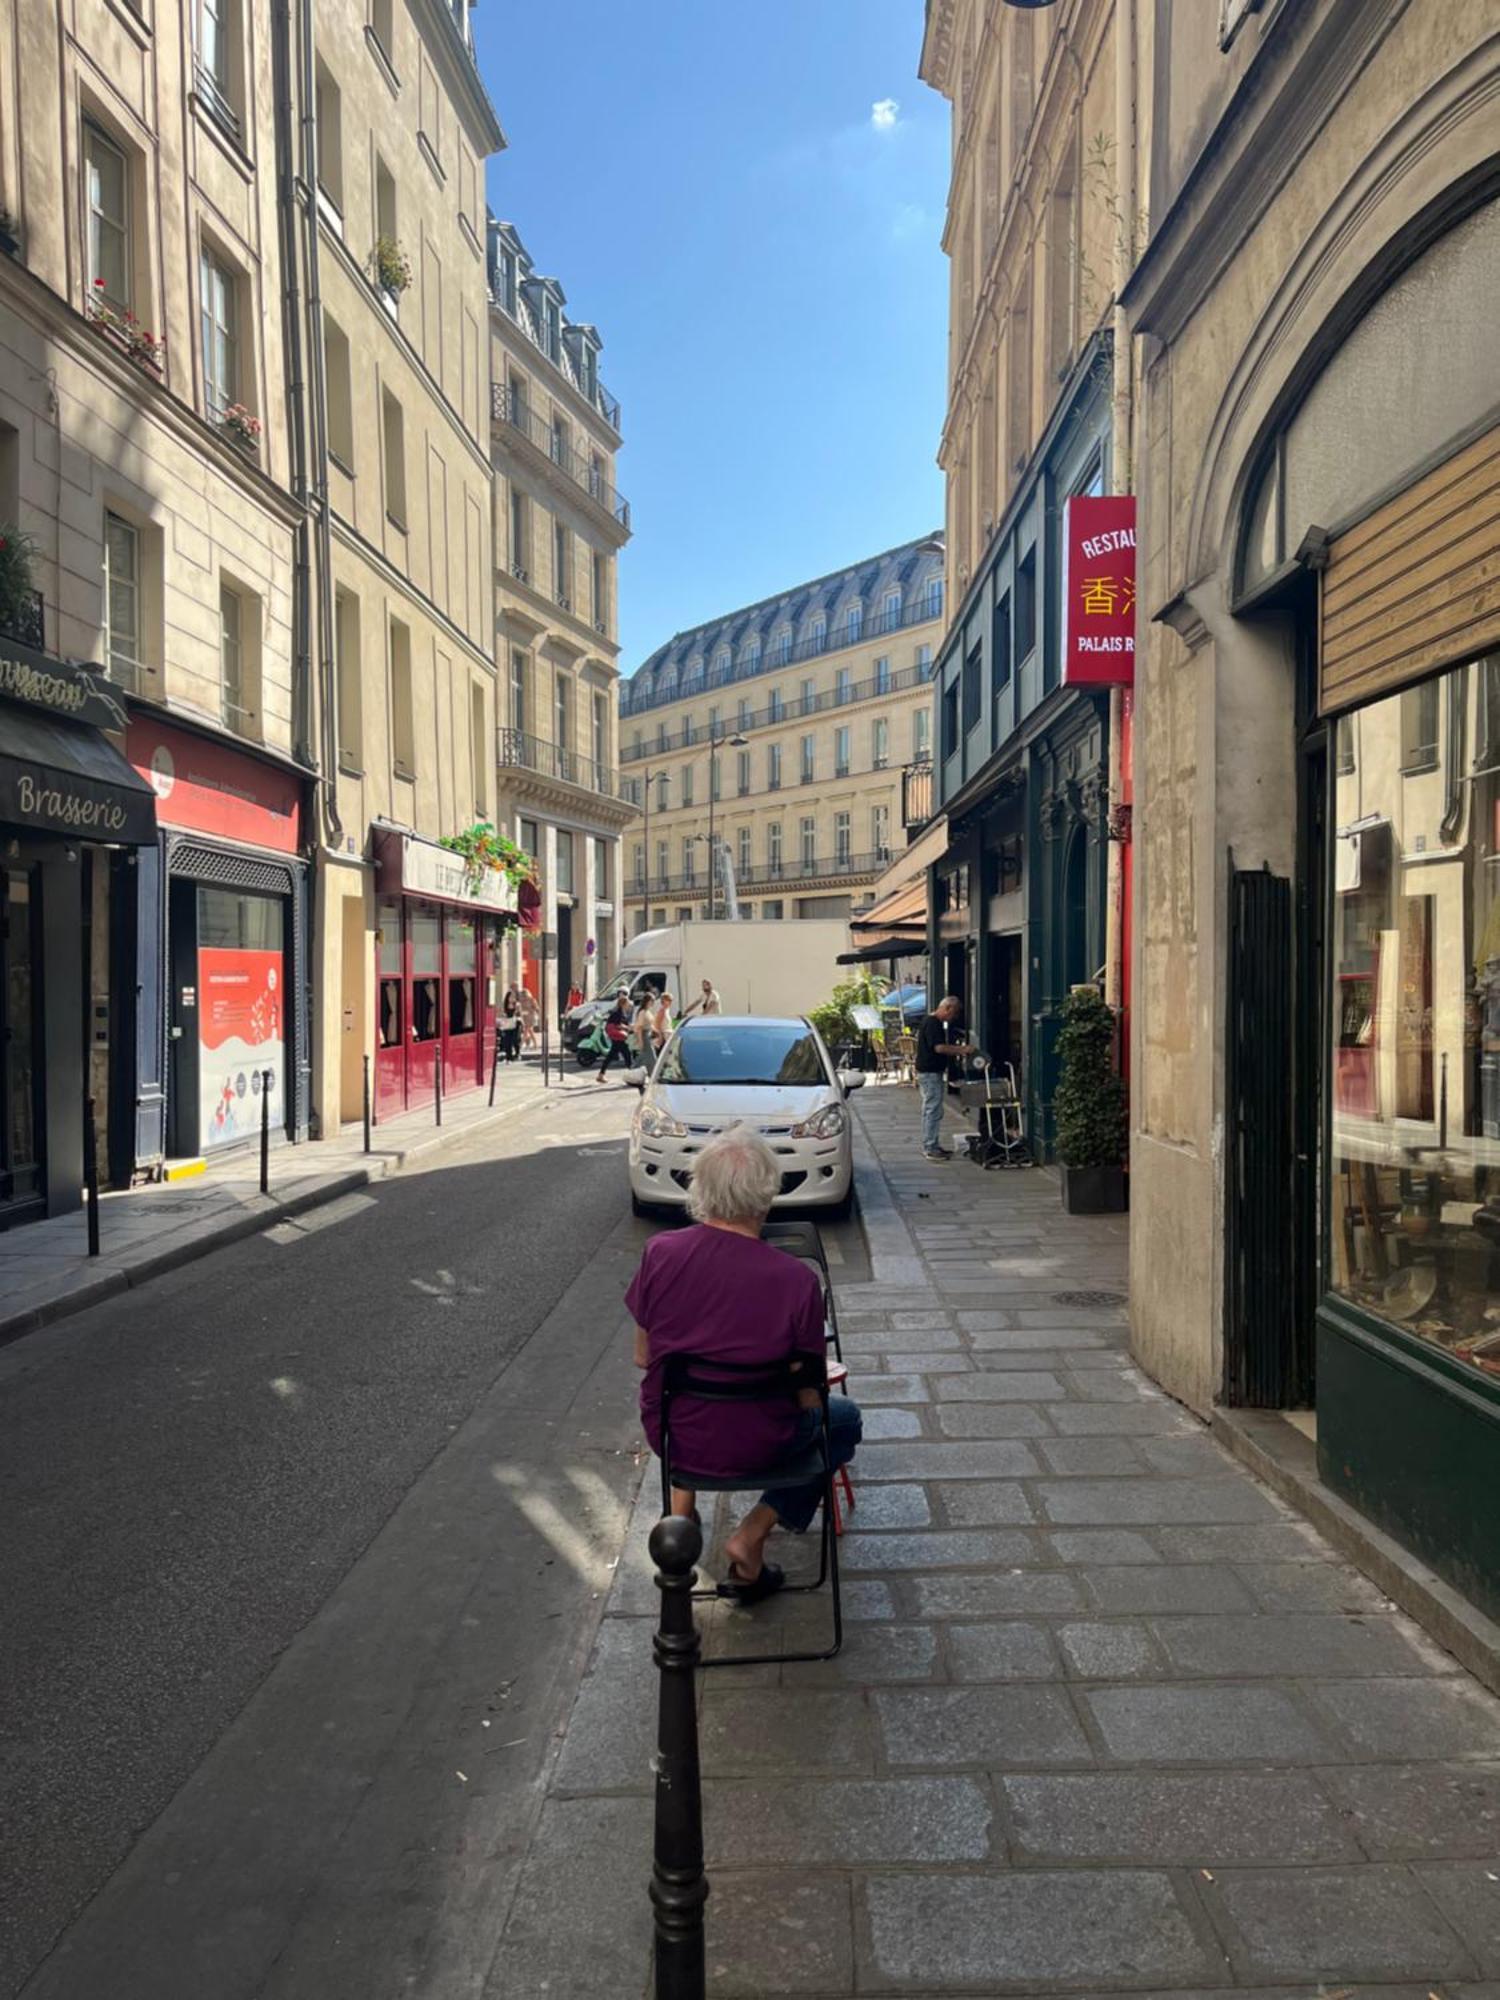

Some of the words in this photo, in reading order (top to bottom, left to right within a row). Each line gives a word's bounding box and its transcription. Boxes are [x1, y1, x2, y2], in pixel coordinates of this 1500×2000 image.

[1078, 637, 1123, 652] PALAIS
[1125, 637, 1136, 652] R
[17, 776, 127, 830] Brasserie
